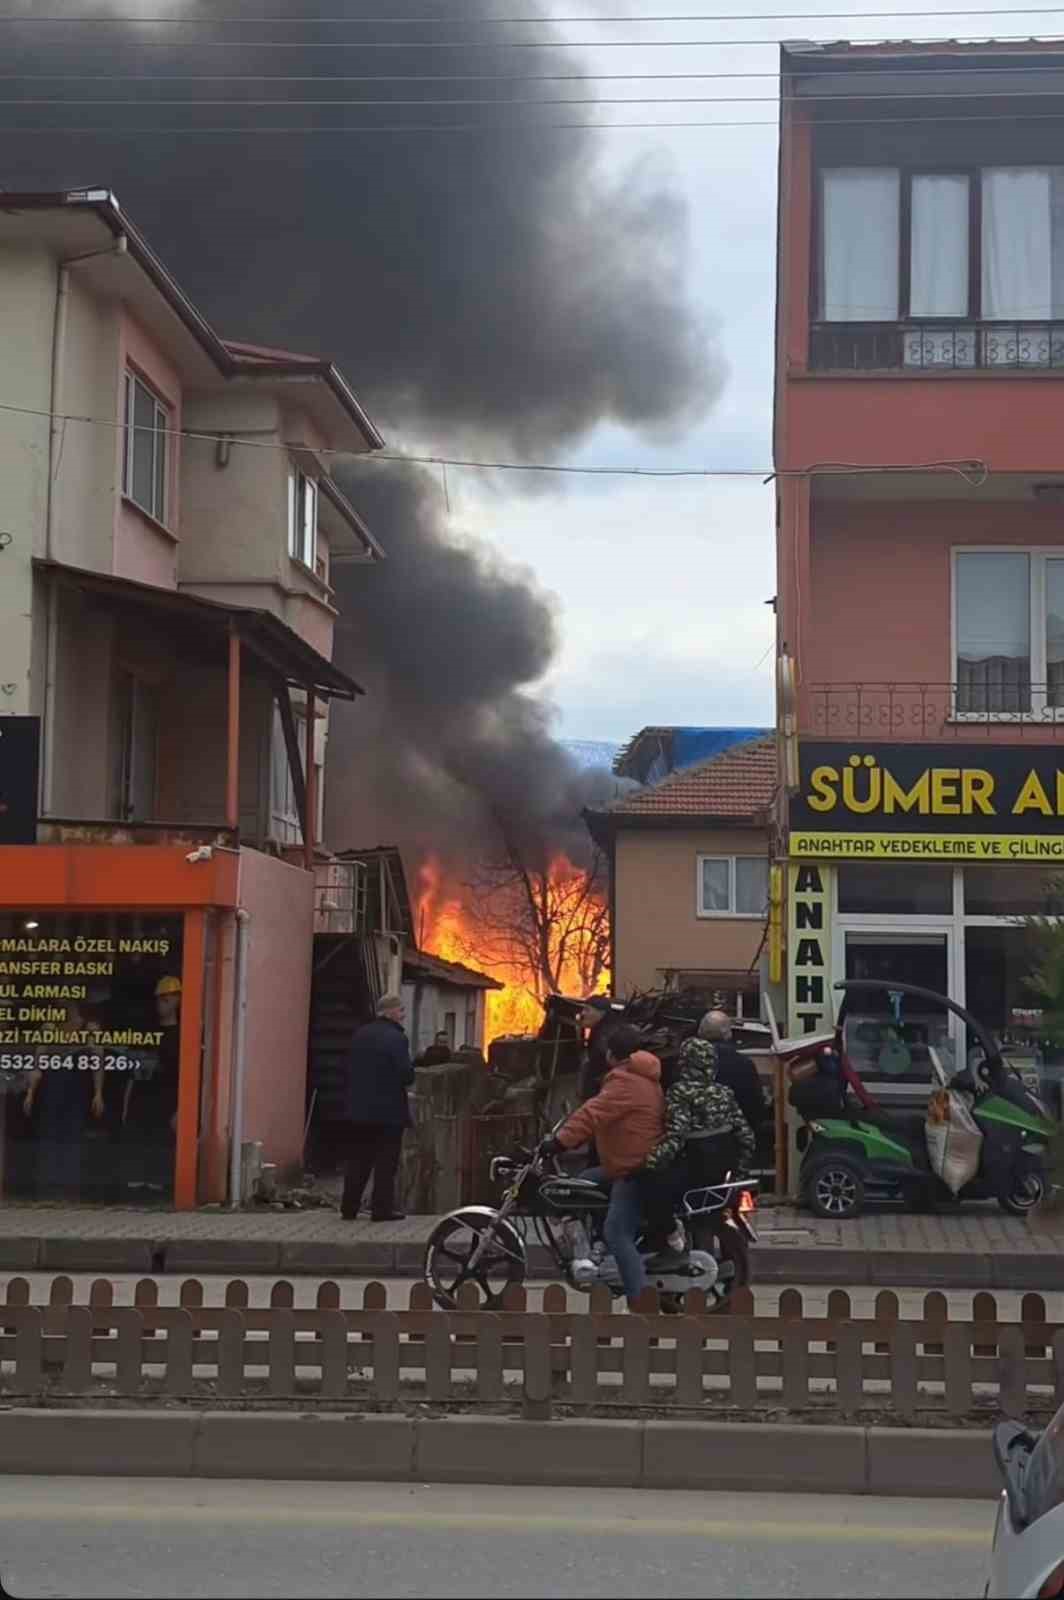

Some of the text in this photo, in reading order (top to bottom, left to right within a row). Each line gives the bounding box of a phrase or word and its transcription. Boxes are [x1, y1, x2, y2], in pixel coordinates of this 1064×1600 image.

[807, 754, 1064, 814] SÜMER A
[798, 838, 875, 852] ANAHTAR
[880, 839, 976, 855] YEDEKLEME
[980, 841, 1001, 854] VE
[73, 935, 116, 953] ÖZEL
[119, 939, 169, 956] NAKIŞ
[64, 961, 113, 976] BASKI
[23, 984, 87, 999] ARMASI
[19, 1004, 67, 1021] DİKİM
[22, 1028, 89, 1044] TADİLAT
[93, 1028, 165, 1046] TAMİRAT
[38, 1055, 74, 1071] 564
[78, 1055, 101, 1071] 83
